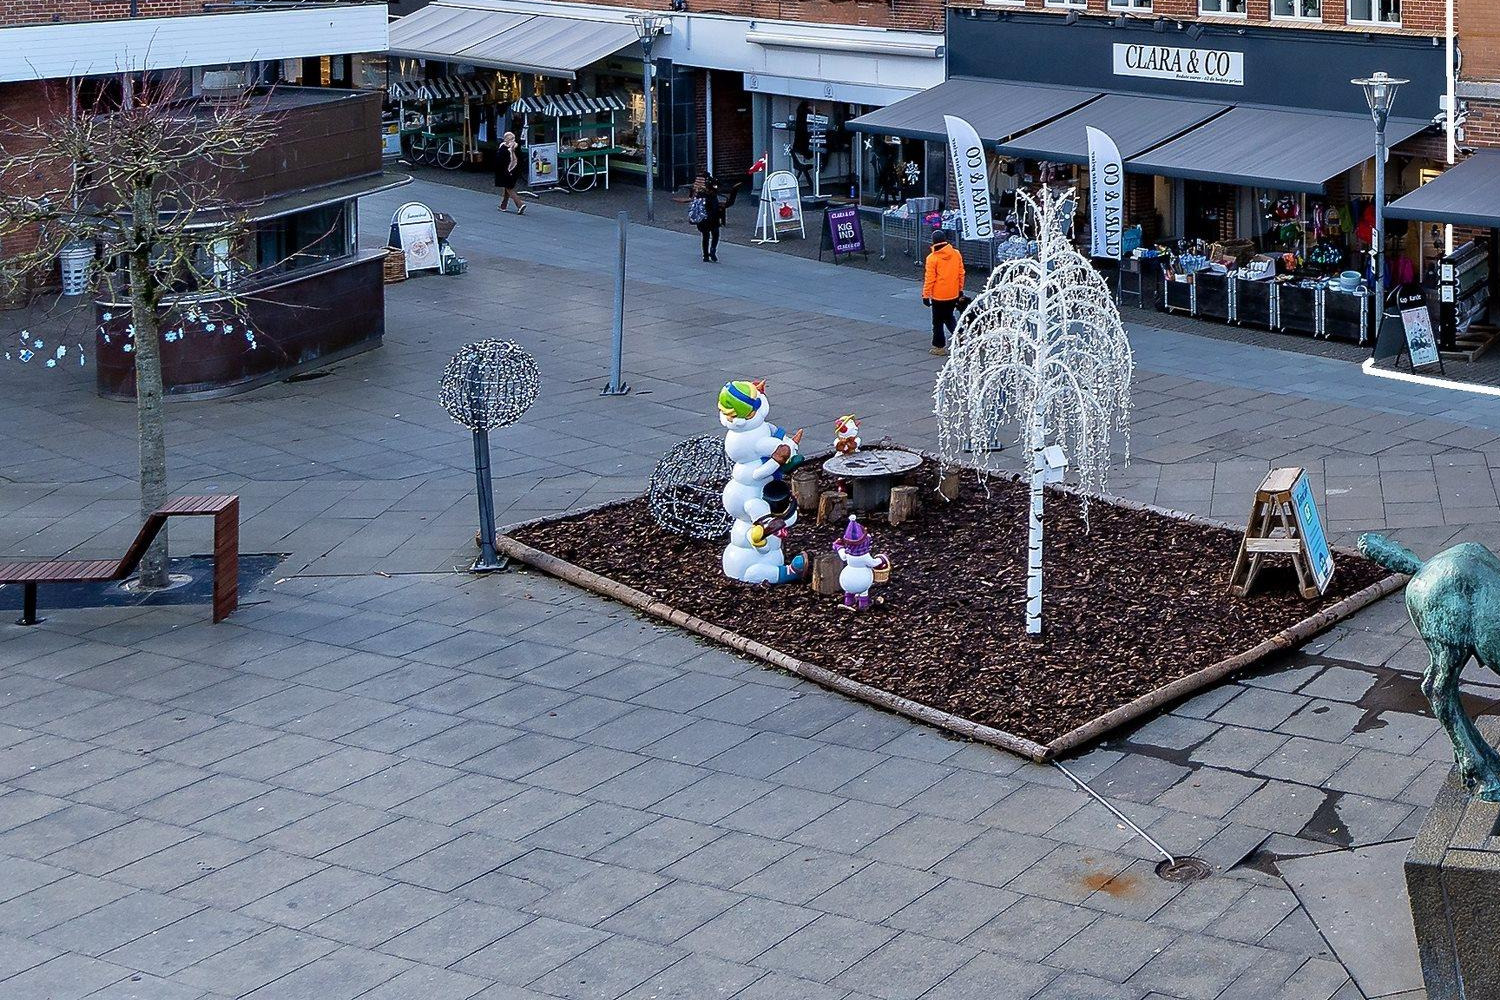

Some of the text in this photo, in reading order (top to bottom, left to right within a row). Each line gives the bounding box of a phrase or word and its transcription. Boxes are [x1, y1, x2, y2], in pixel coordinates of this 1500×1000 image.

[1126, 45, 1230, 76] CLARA & CO
[837, 222, 853, 231] KIG
[838, 230, 855, 239] IND
